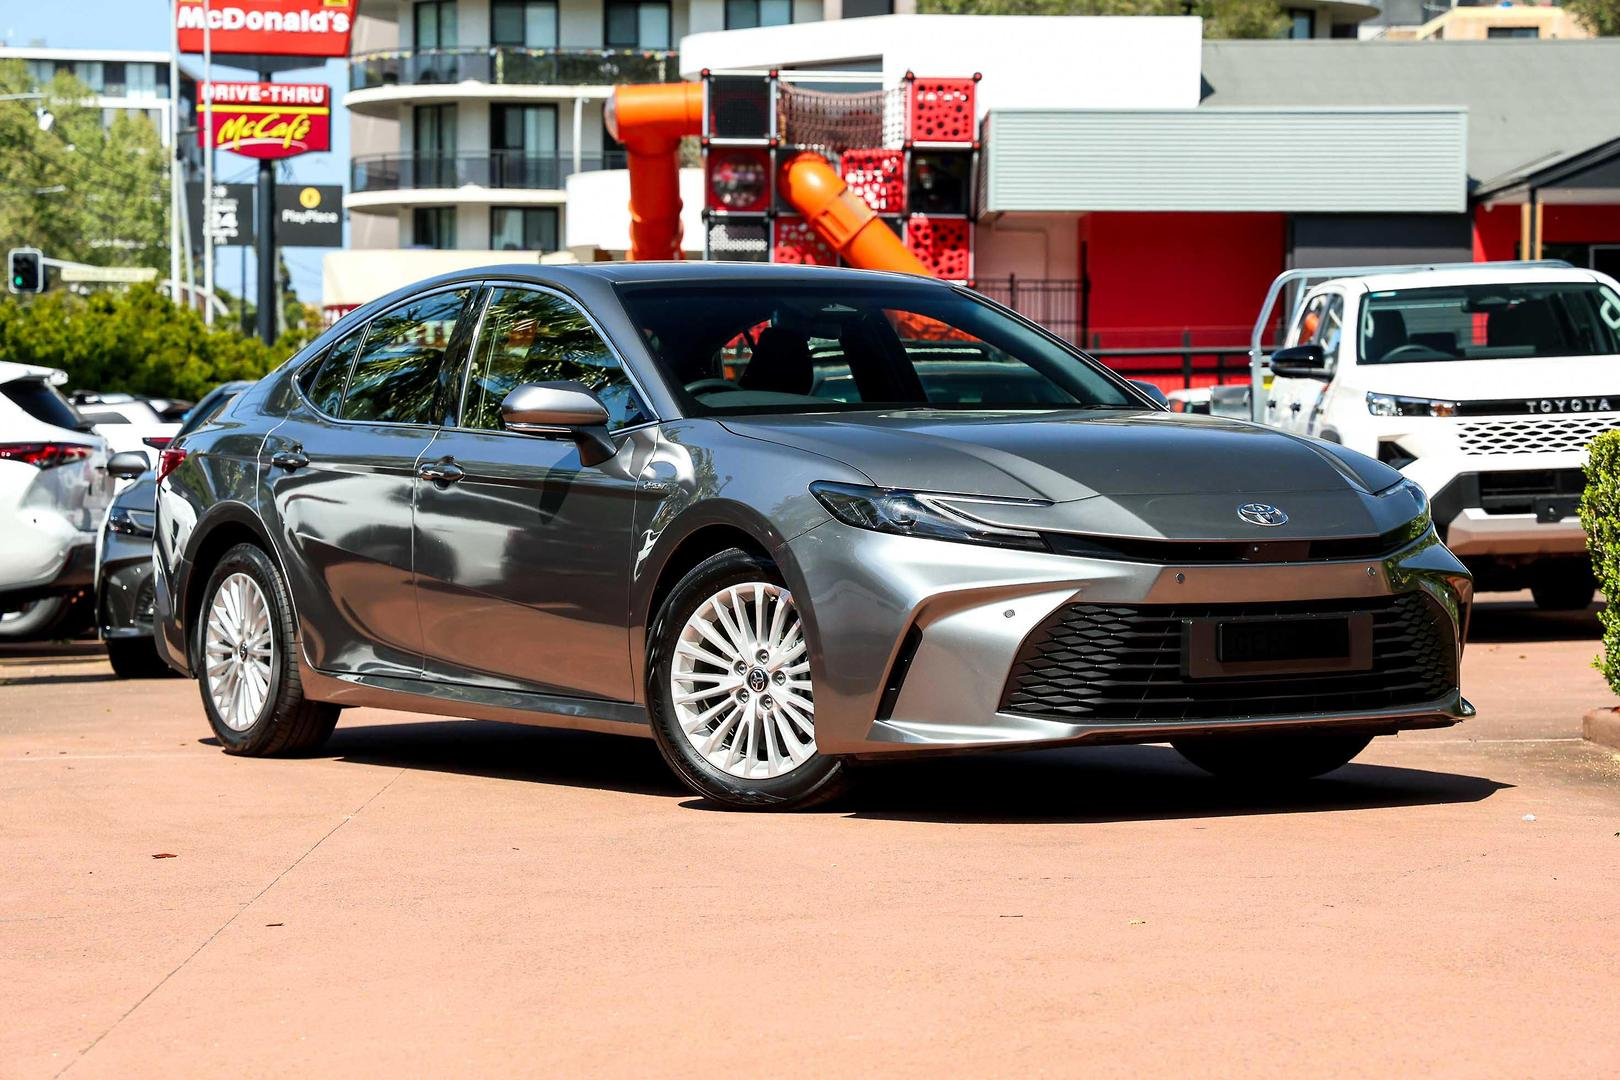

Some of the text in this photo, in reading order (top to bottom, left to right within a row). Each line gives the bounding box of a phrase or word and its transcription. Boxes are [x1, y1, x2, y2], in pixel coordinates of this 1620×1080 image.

[177, 6, 349, 32] McDonald's
[282, 209, 338, 224] PlayPlace
[1526, 398, 1611, 413] TOYOTA
